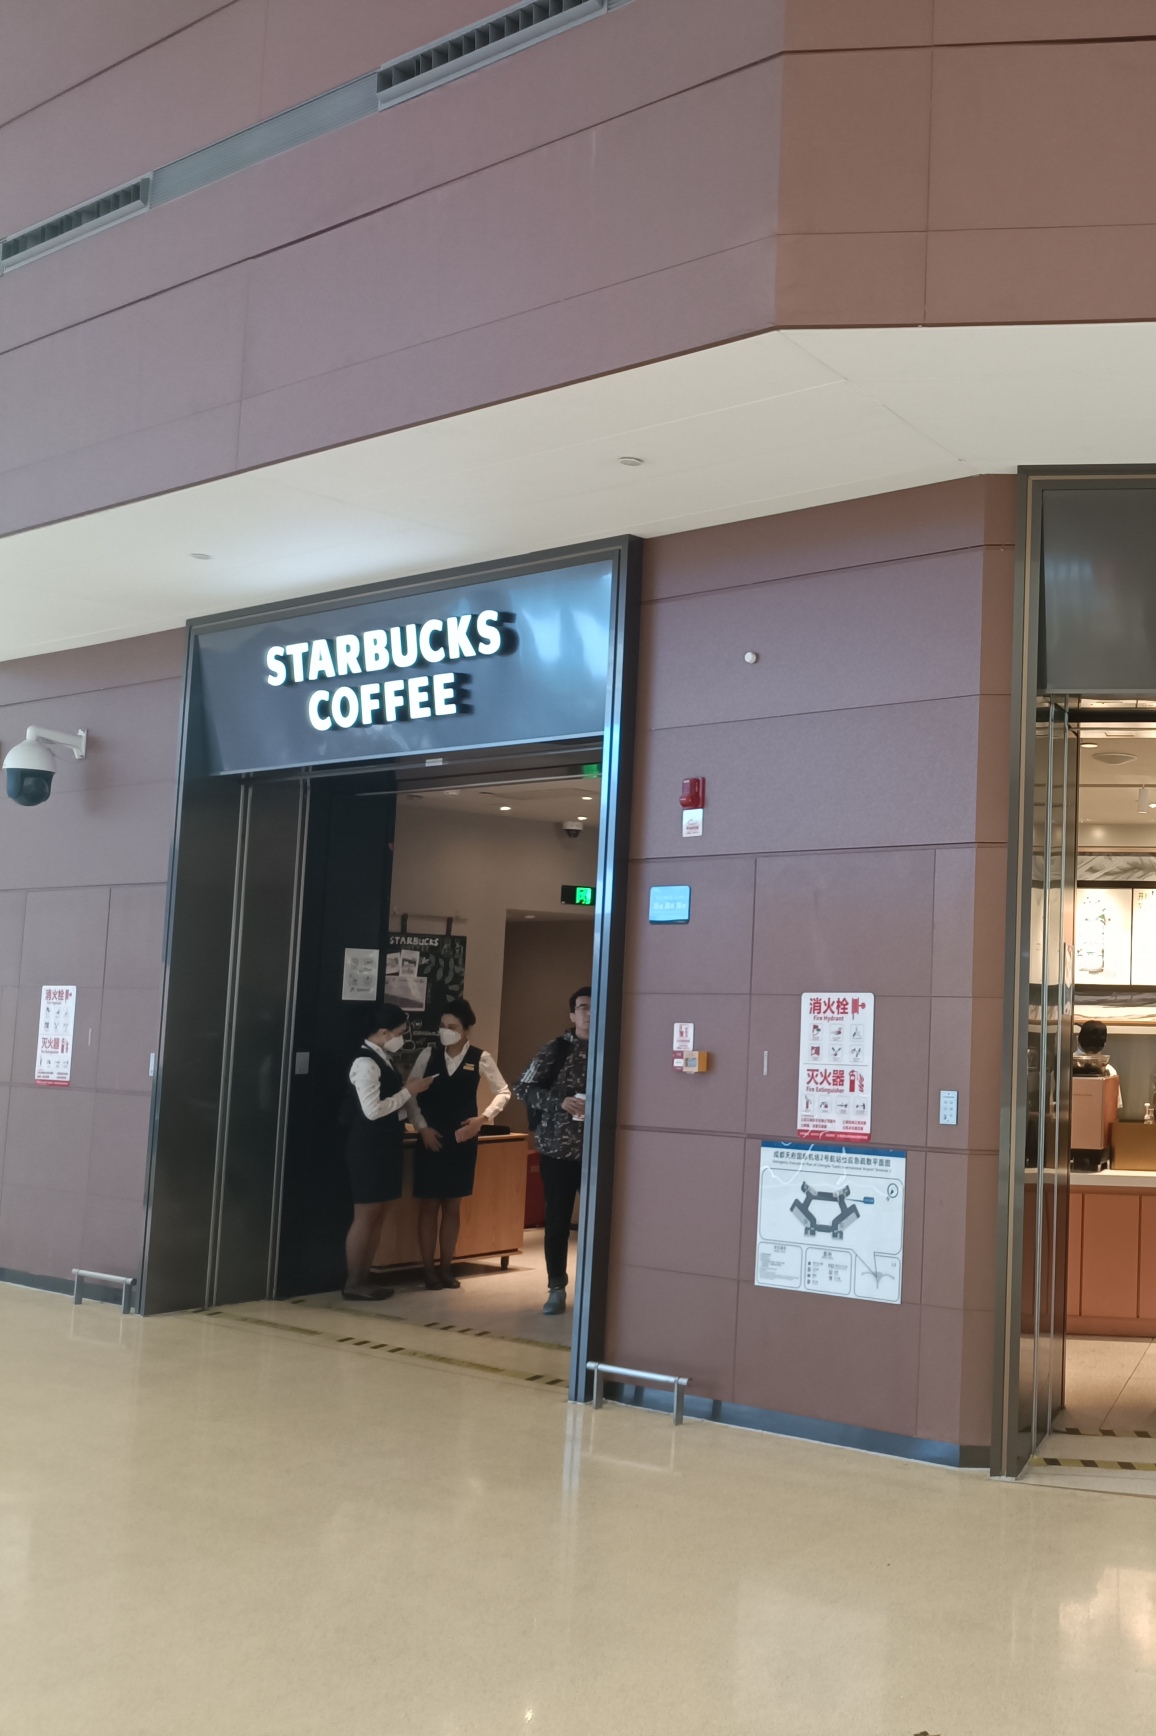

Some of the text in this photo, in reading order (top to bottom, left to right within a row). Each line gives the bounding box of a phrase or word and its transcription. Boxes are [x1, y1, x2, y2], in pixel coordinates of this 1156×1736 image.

[266, 609, 502, 687] STARBUCKS
[308, 672, 457, 732] COFFEE
[389, 935, 440, 947] STARBUCKS
[45, 988, 65, 1001] 消火栓
[809, 997, 849, 1015] 消火栓
[824, 1015, 845, 1023] Hydrant
[41, 1037, 60, 1050] 灭火器
[806, 1068, 845, 1087] 灭火器
[816, 1087, 845, 1095] Extinguisher
